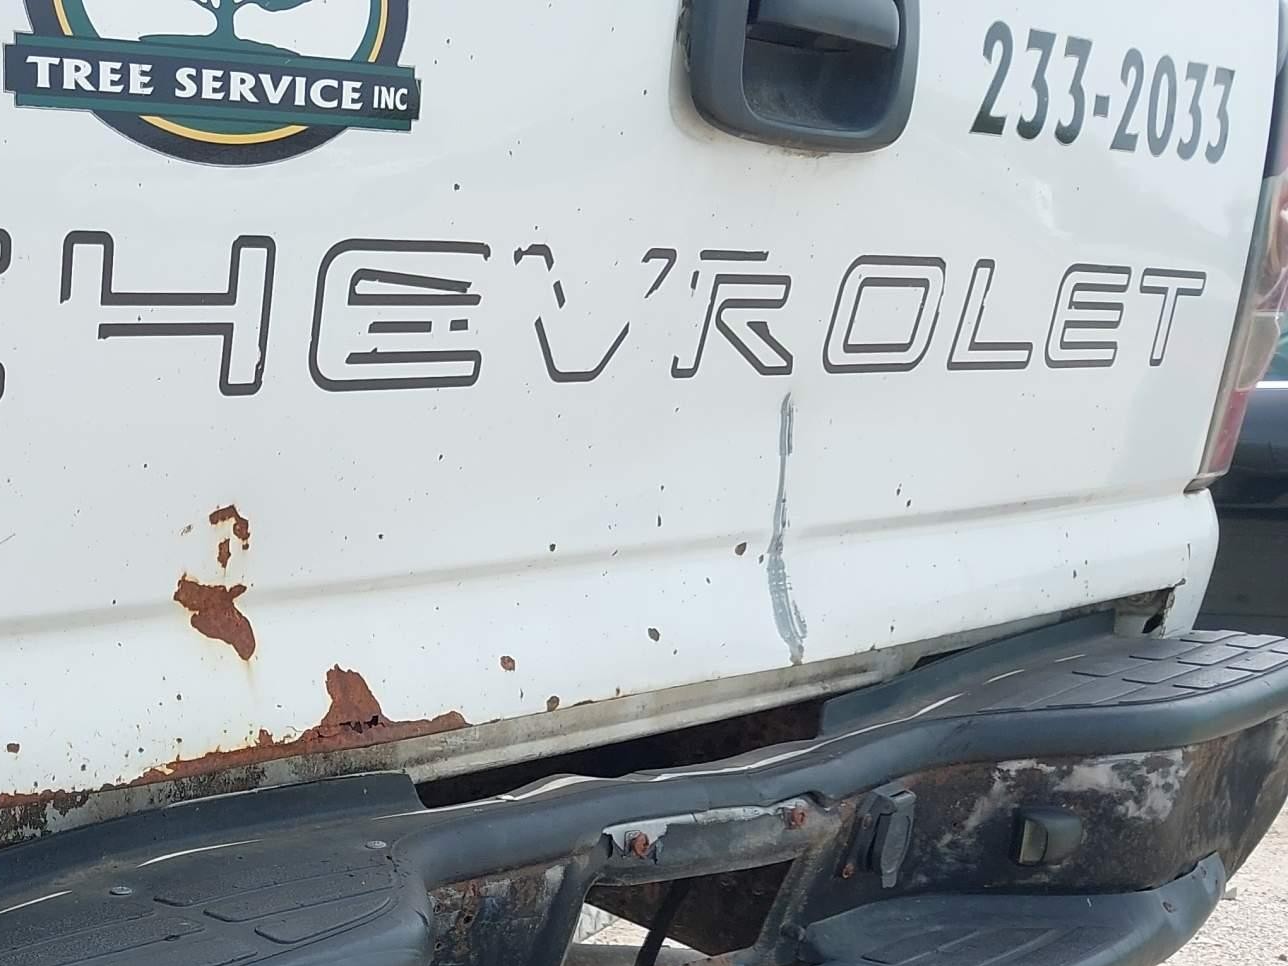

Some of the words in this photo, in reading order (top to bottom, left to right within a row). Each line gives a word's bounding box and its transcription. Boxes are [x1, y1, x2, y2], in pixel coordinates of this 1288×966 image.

[25, 55, 154, 96] TREE
[174, 67, 364, 110] SERVICE
[372, 85, 409, 112] INC
[969, 20, 1236, 164] 233-2033
